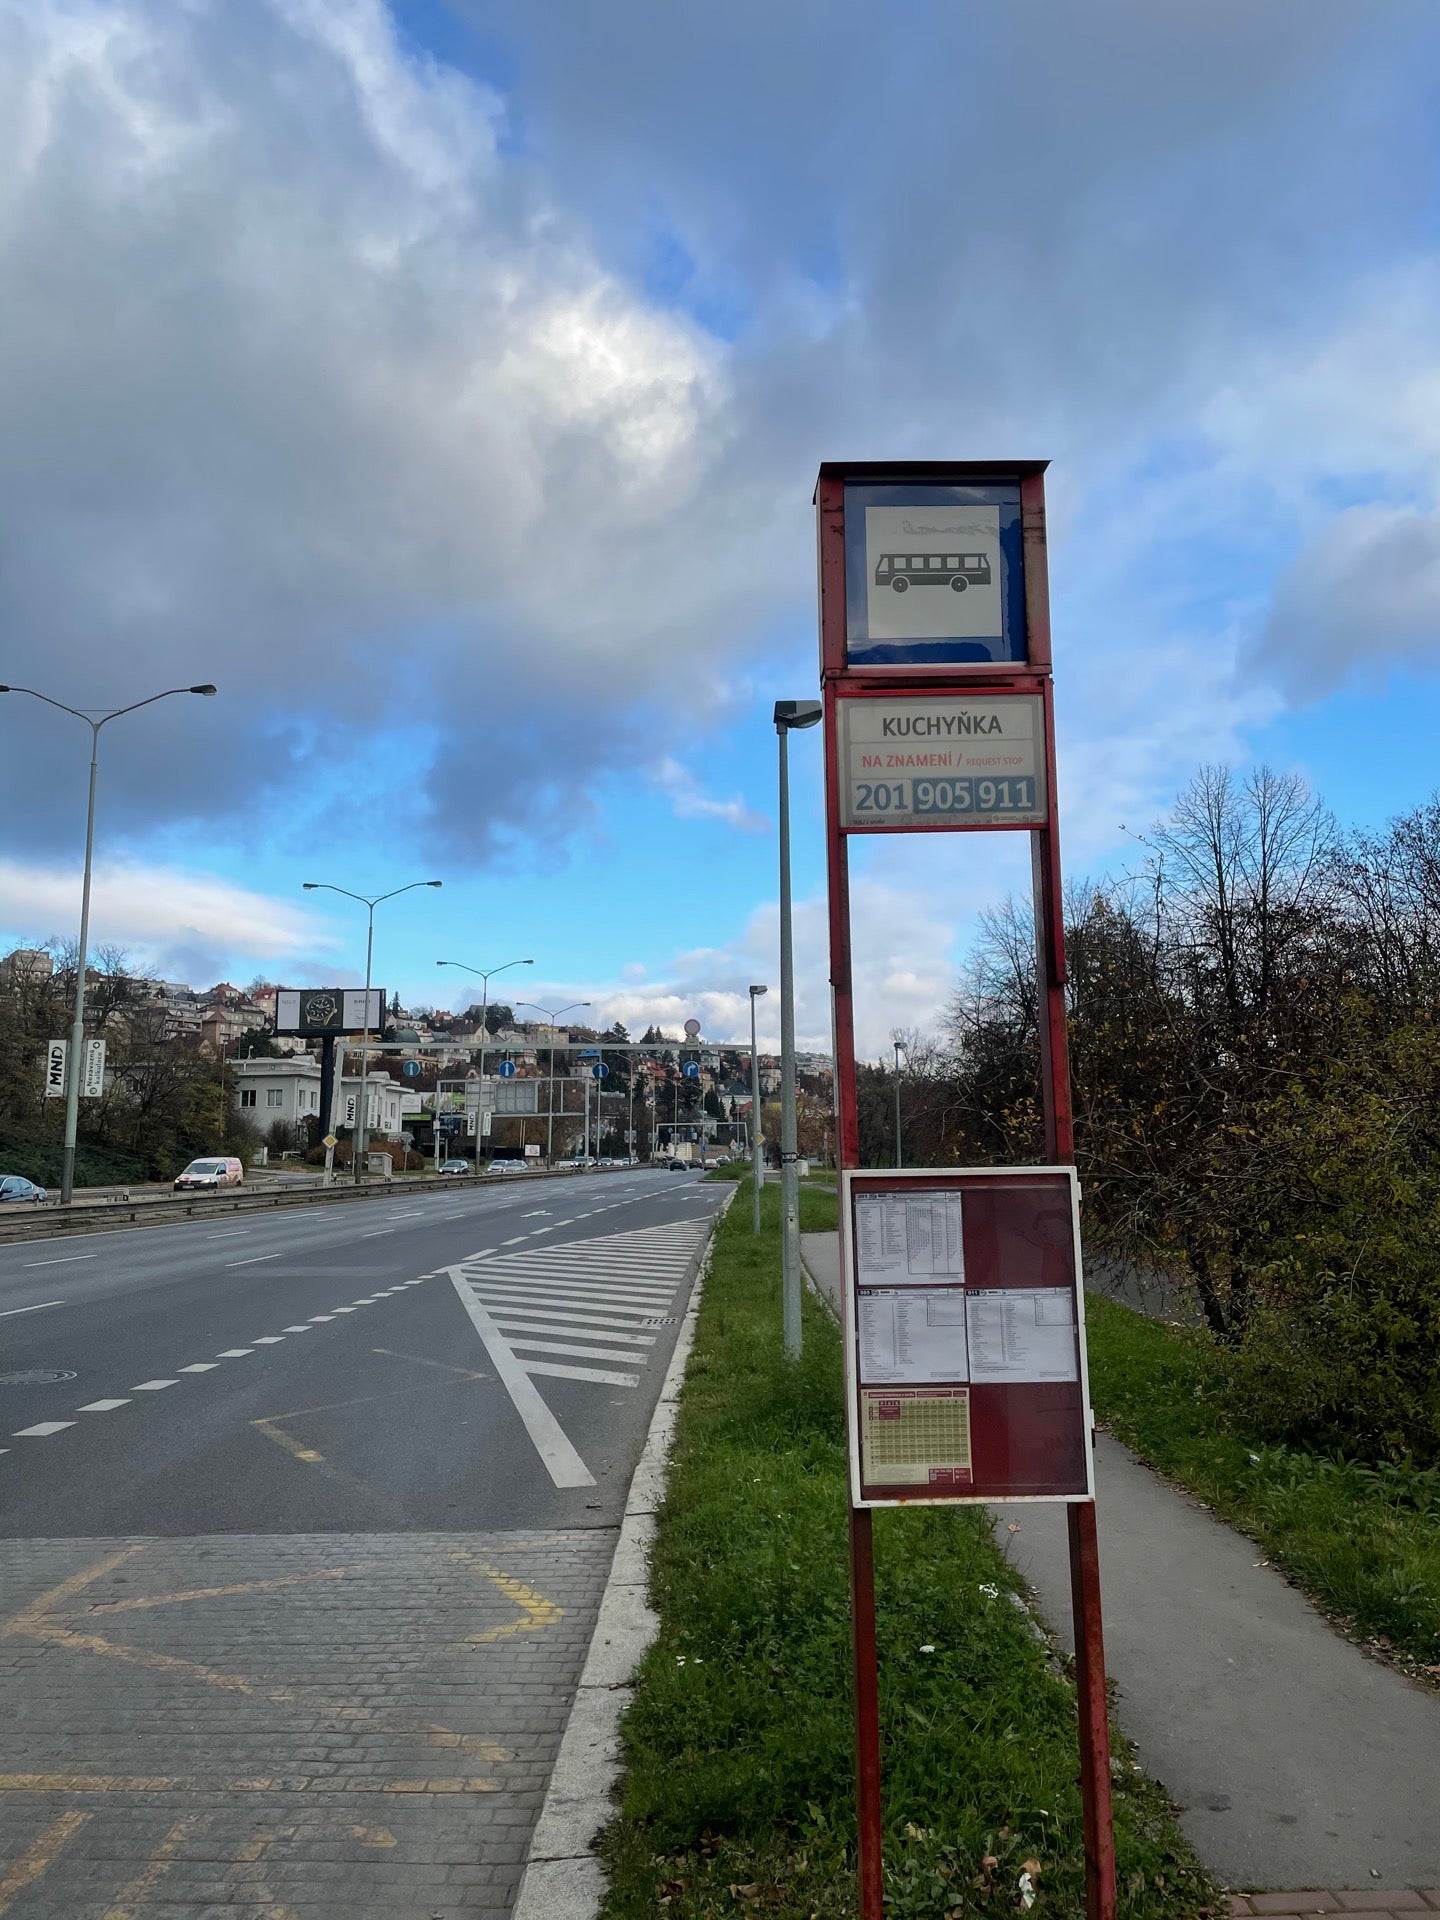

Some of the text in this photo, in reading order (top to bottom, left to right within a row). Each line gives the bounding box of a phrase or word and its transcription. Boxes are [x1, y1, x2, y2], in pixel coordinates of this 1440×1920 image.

[883, 711, 1003, 736] KUCHYŇKA
[862, 755, 882, 768] NA
[886, 750, 952, 768] ZNAMENÍ
[966, 757, 1001, 767] REQUEST
[1004, 756, 1023, 766] STOP
[856, 780, 1032, 811] 201 905 911
[50, 1046, 64, 1086] MND
[346, 1097, 355, 1121] MND
